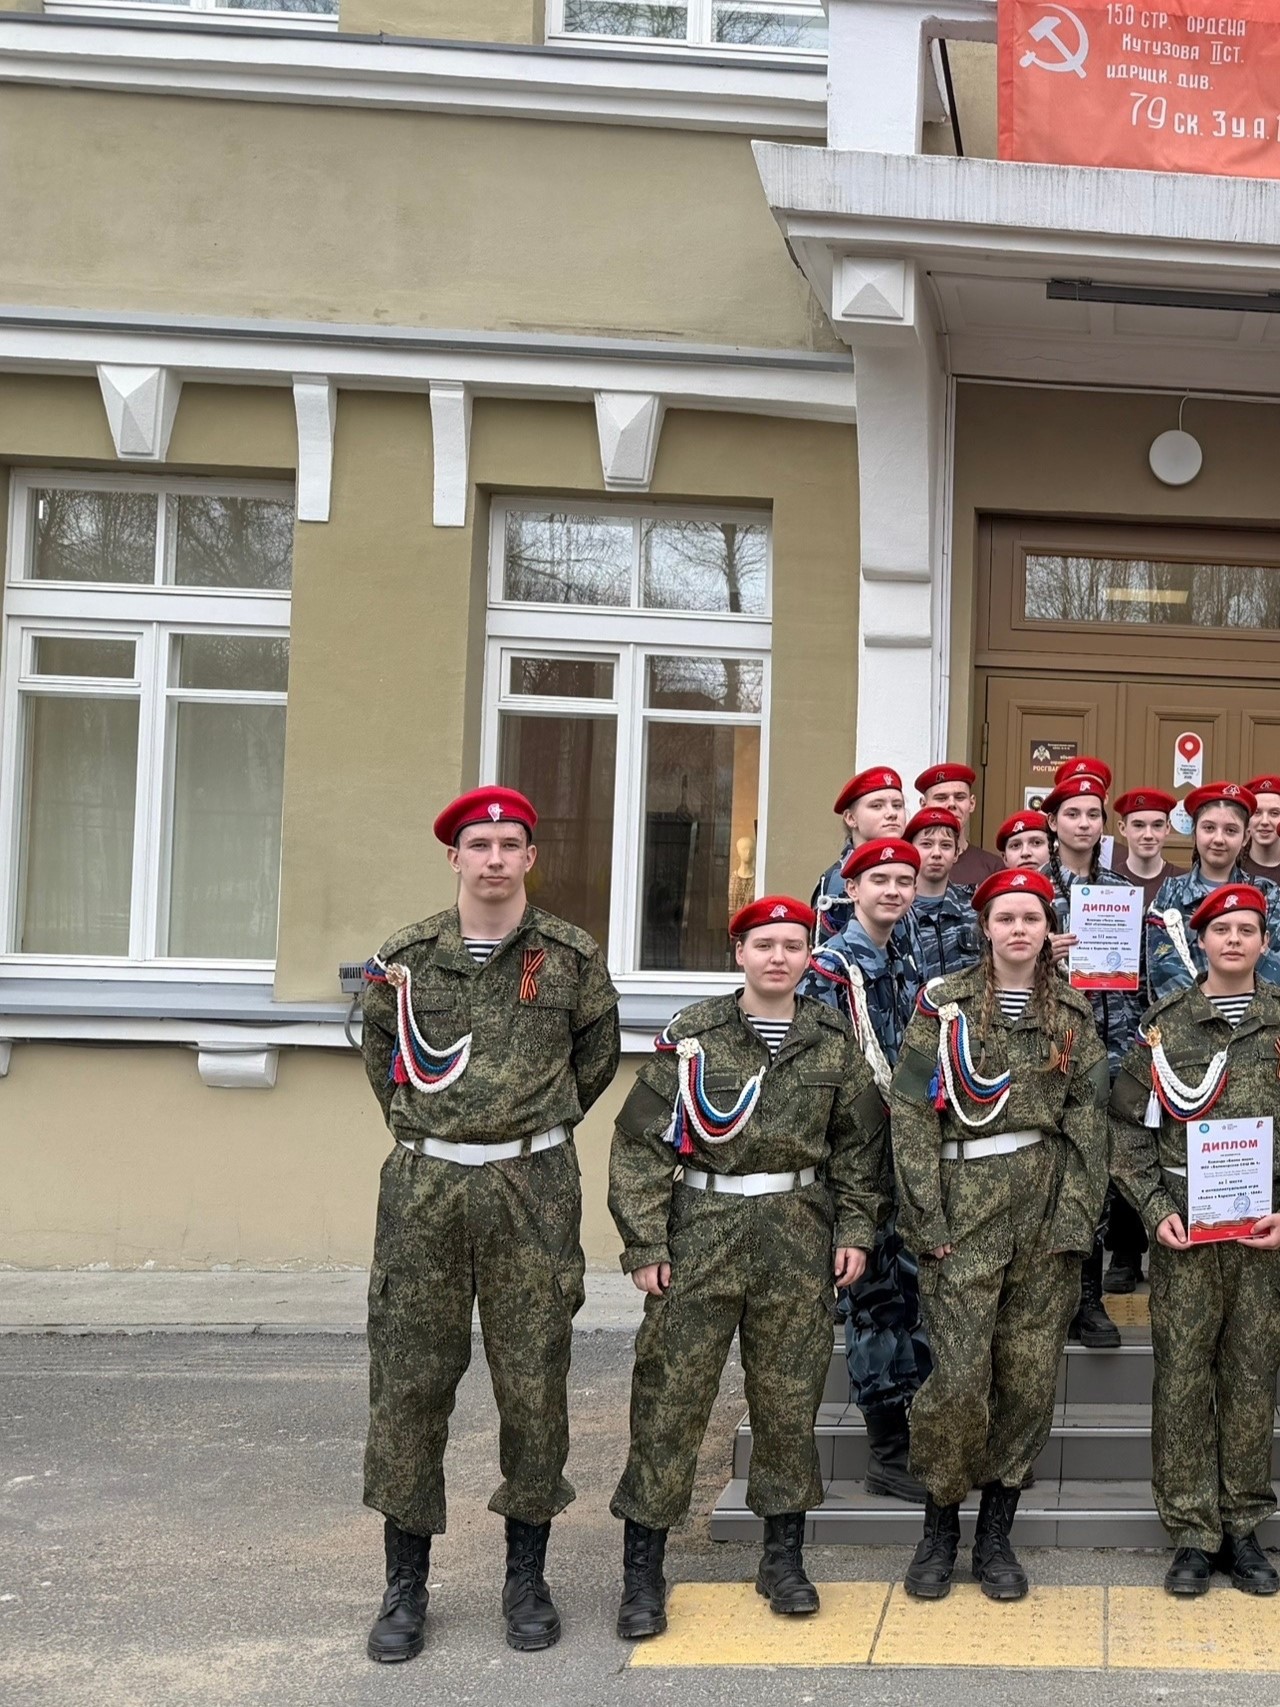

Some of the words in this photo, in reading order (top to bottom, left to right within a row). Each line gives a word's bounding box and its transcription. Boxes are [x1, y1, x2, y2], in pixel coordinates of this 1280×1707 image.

[1106, 3, 1134, 25] 150
[1187, 16, 1246, 36] ОРДЕНА
[1130, 92, 1167, 129] 79
[1082, 903, 1131, 912] ДИПЛОМ
[1201, 1139, 1258, 1153] ДИПЛОМ
